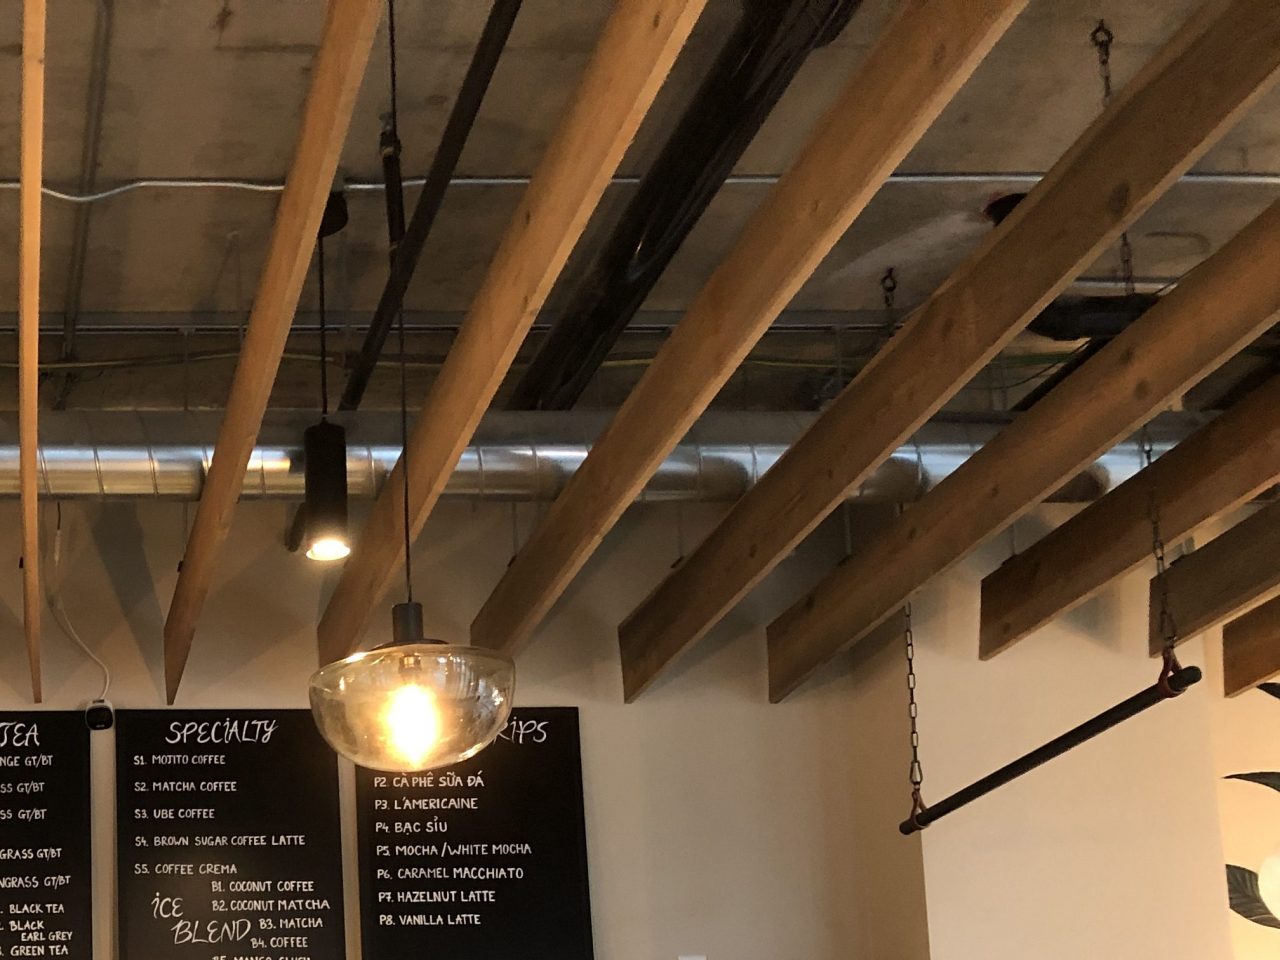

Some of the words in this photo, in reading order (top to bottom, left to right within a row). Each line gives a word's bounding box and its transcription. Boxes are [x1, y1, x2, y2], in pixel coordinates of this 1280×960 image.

[0, 722, 39, 747] TEA
[25, 754, 53, 767] GT/BT
[134, 756, 147, 765] S1.
[152, 755, 188, 764] MOJITO
[192, 755, 225, 764] COFFEE
[393, 772, 409, 787] CÀ
[411, 770, 434, 787] PHÊ
[17, 781, 45, 793] GT/BT
[153, 782, 195, 791] MATCHA
[200, 782, 236, 791] COFFEE
[375, 800, 389, 809] P3.
[18, 808, 47, 821] GT/BT
[135, 809, 148, 818] S3.
[154, 809, 174, 818] UBE
[178, 809, 214, 818] COFFEE
[376, 822, 390, 832] P4.
[395, 822, 420, 835] BẠC
[135, 836, 148, 846] S4.
[154, 836, 188, 846] BROWN
[195, 836, 228, 846] SUGAR
[231, 836, 266, 845] COFFEE
[272, 835, 305, 845] LATTE
[37, 848, 62, 860] GT/BT
[377, 845, 390, 856] P5.
[396, 845, 438, 855] MOCHA
[492, 844, 531, 854] MOCHA
[135, 864, 149, 874] S5.
[155, 864, 193, 874] COFFEE
[199, 864, 237, 874] CREMA
[377, 869, 392, 879] P6.
[398, 868, 449, 878] CARAMEL
[453, 867, 523, 879] MACCHIATO
[44, 875, 71, 889] GT/BT
[212, 881, 225, 892] B1.
[230, 881, 272, 891] COCONUT
[277, 881, 314, 891] COFFEE
[379, 892, 393, 902] P7.
[398, 891, 456, 902] HAZELNUT
[461, 890, 495, 901] LATTE
[10, 904, 43, 913] BLACK
[45, 904, 64, 913] TEA
[212, 900, 228, 911] B2.
[230, 900, 274, 911] COCONUT
[278, 900, 330, 911] MATCHA
[259, 919, 276, 929] B3.
[280, 918, 323, 928] MATCHA
[380, 915, 395, 925] P8.
[399, 915, 443, 925] VANILLA
[448, 914, 480, 924] LATTE
[9, 920, 44, 931] BLACK
[21, 932, 45, 941] EARL
[49, 931, 72, 940] GREY
[171, 919, 251, 944] BLEND
[251, 938, 267, 948] B4.
[270, 937, 307, 947] COFFEE
[10, 946, 44, 956] GREEN
[49, 945, 68, 955] TEA
